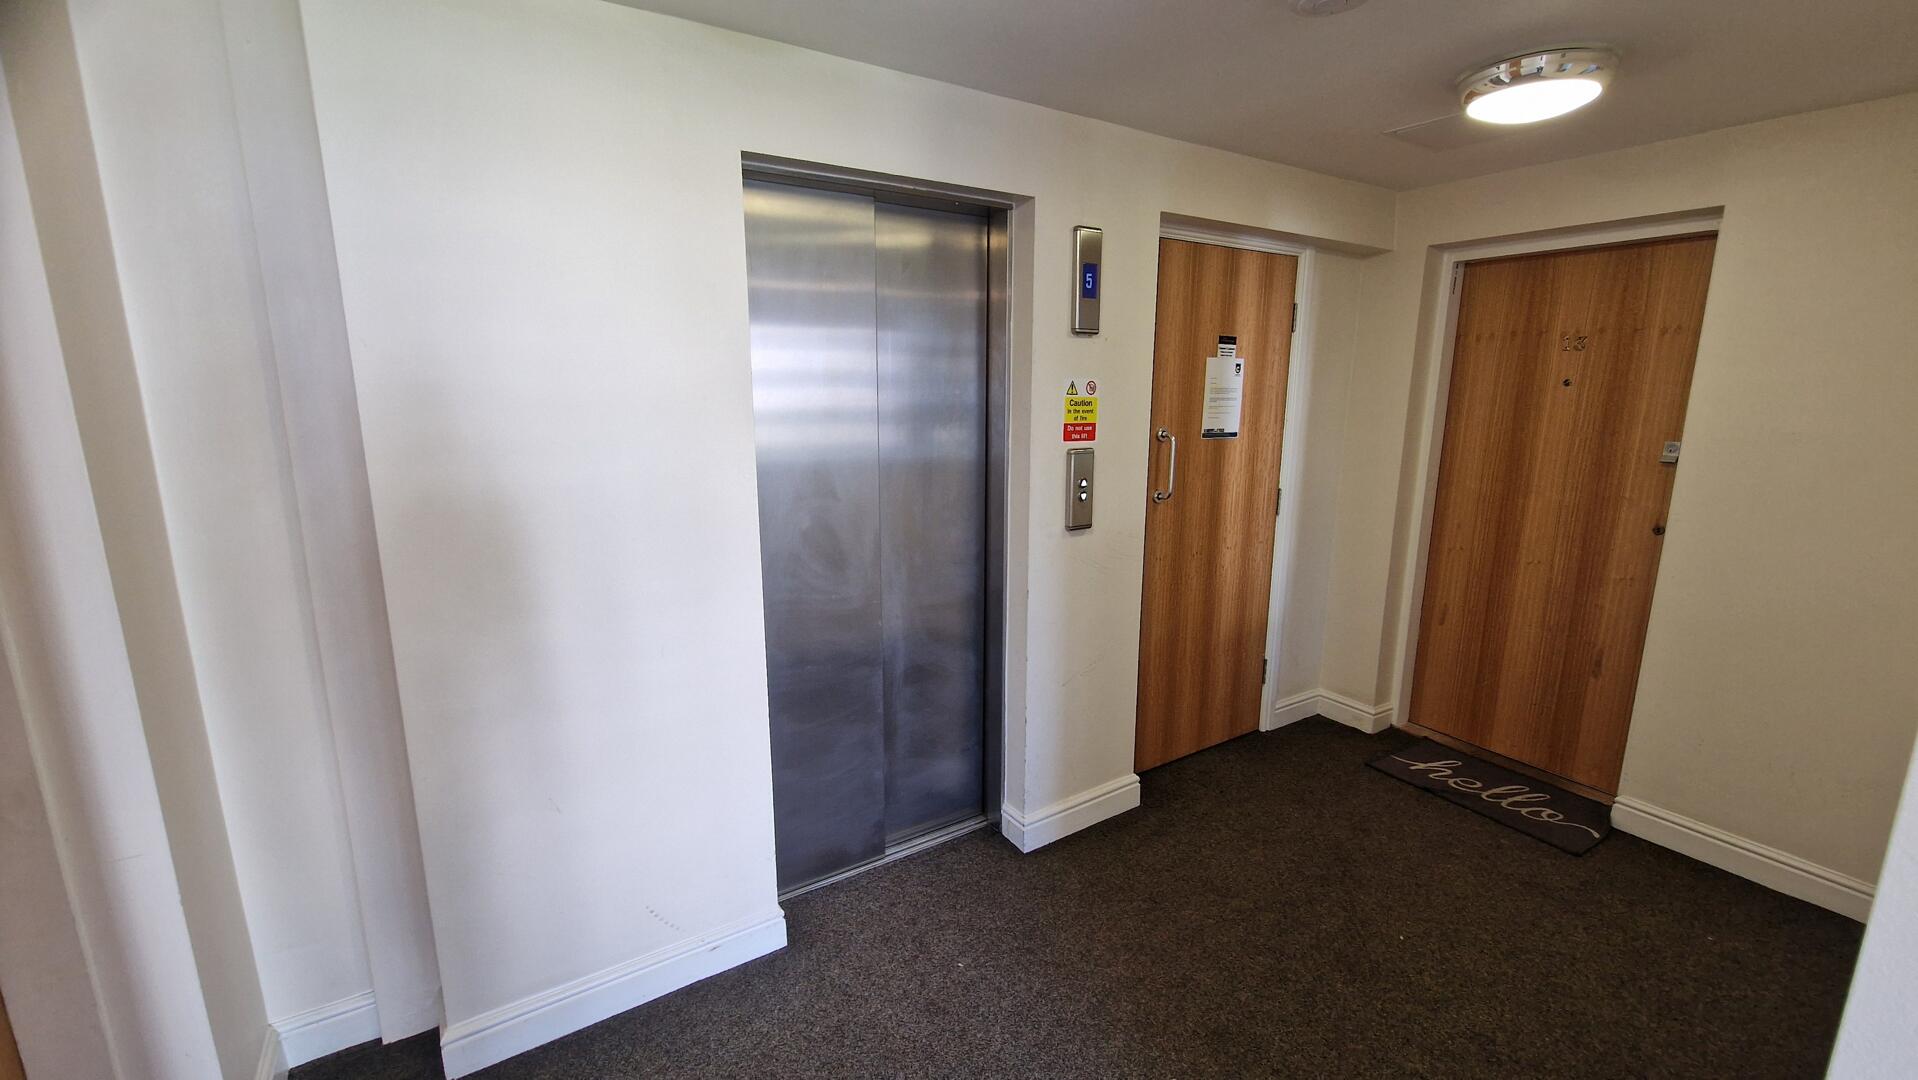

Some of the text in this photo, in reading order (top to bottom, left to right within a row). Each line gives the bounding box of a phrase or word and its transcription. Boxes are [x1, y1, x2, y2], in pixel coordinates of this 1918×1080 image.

[1085, 273, 1093, 289] 5
[1561, 336, 1588, 351] 13
[1069, 399, 1093, 407] Caution
[1391, 755, 1600, 839] hello
